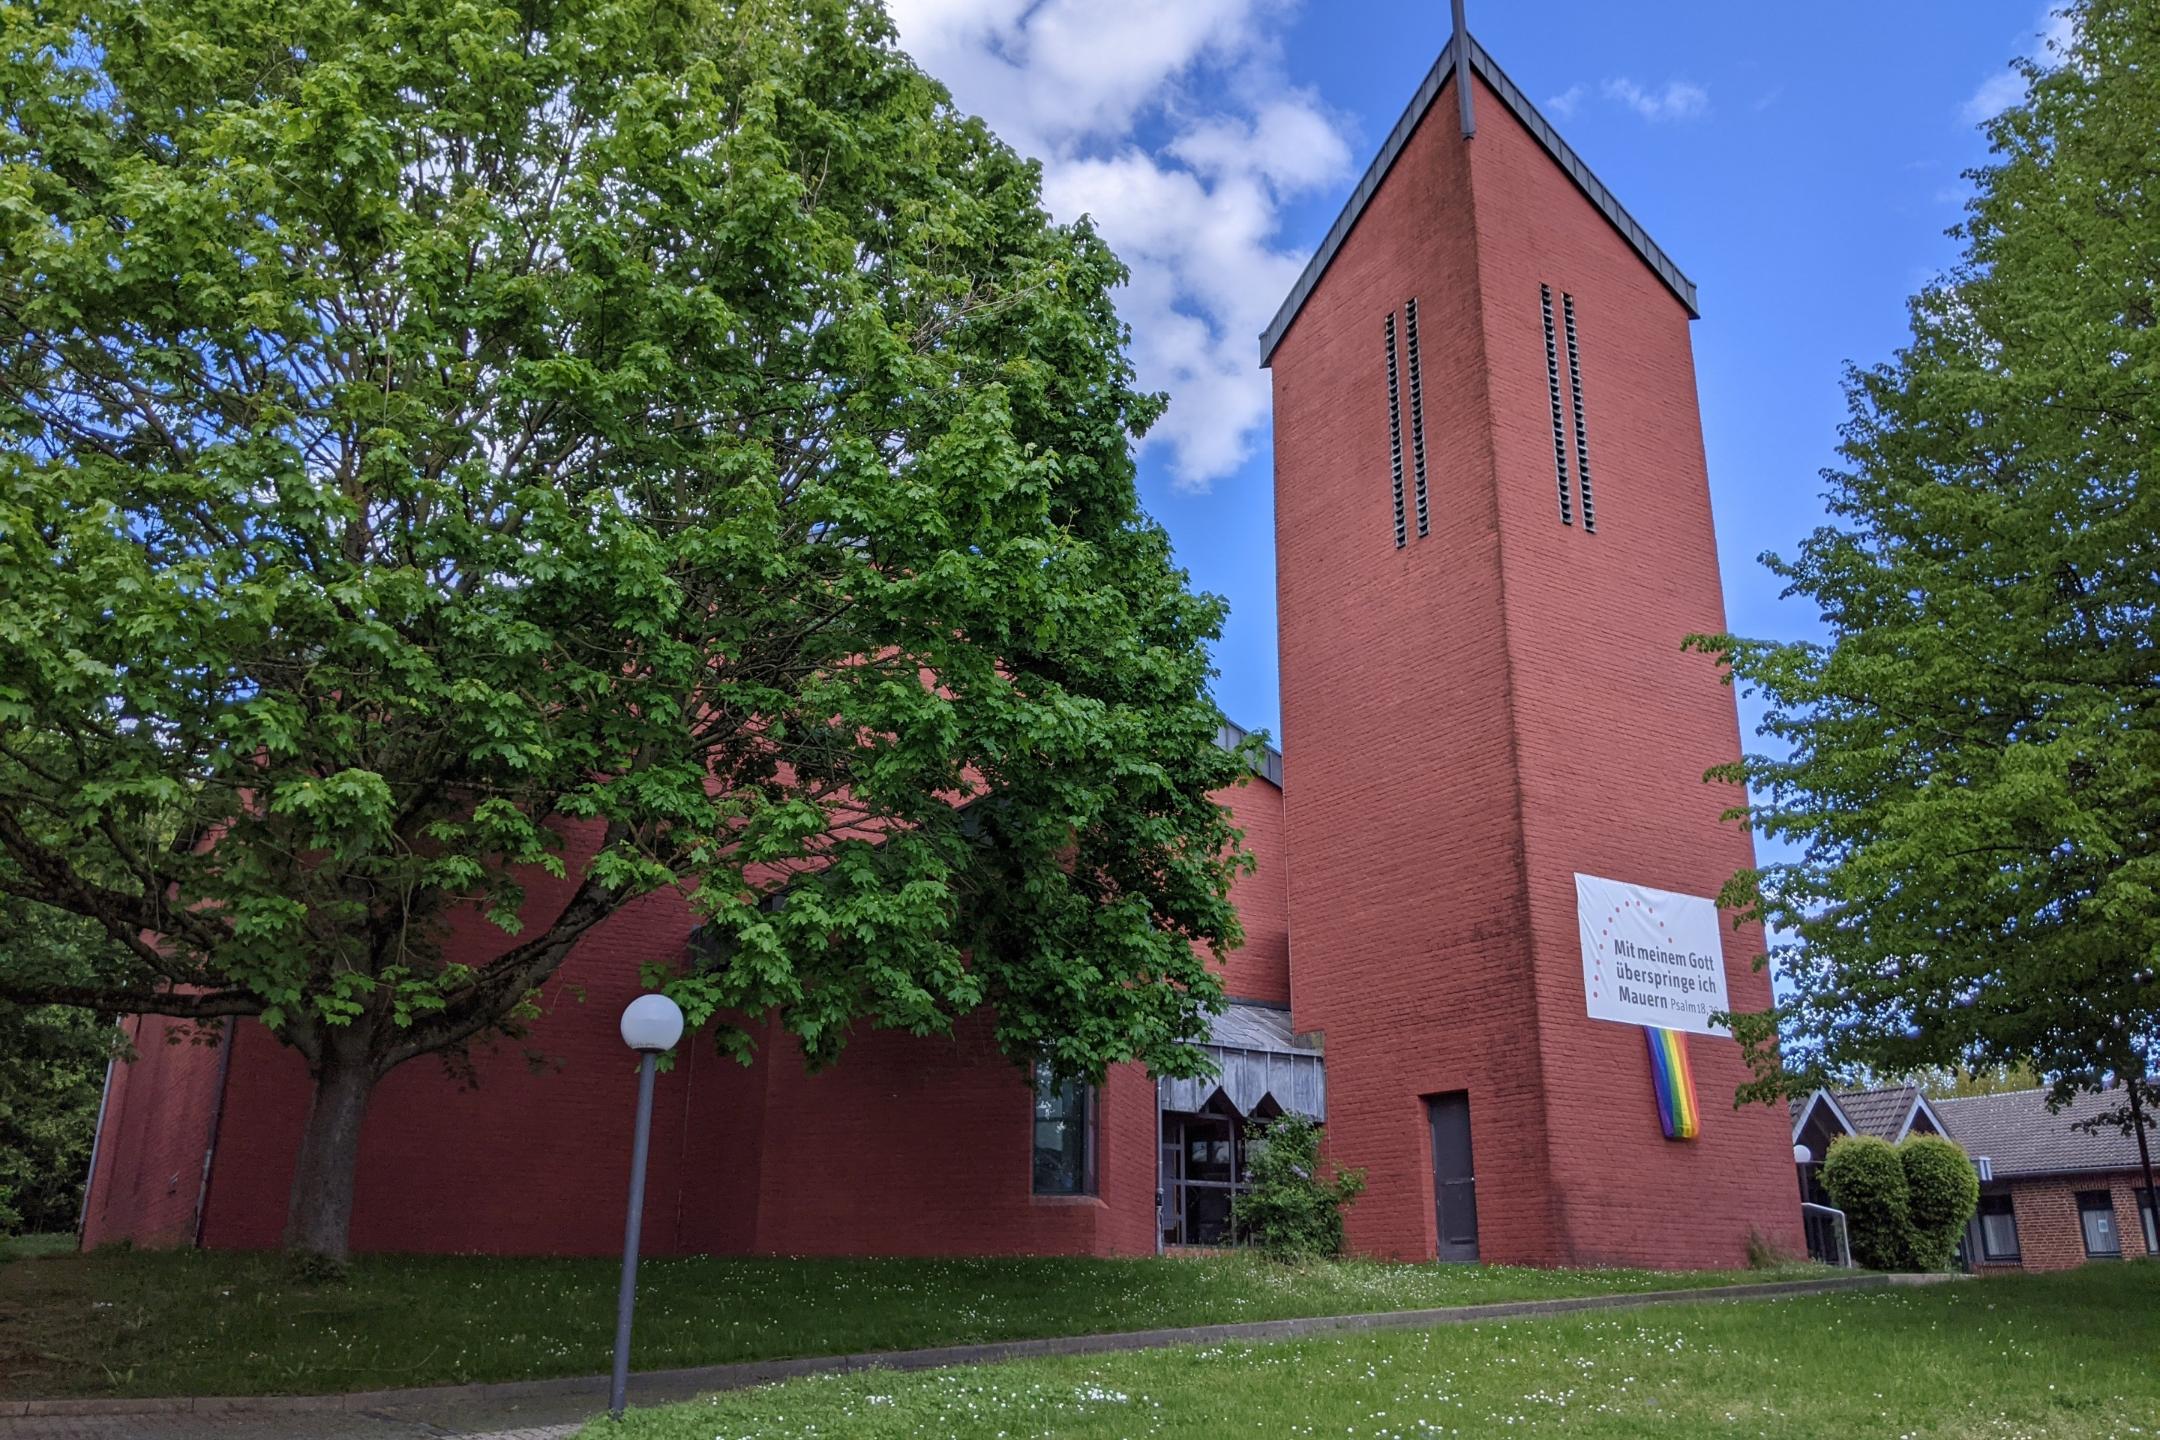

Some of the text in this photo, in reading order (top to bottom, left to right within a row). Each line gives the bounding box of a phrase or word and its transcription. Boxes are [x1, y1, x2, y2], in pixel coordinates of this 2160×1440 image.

[1614, 939, 1714, 971] Mit meinem Gott
[1616, 962, 1716, 993] überspringe ich
[1619, 985, 1667, 1009] Mauern
[1671, 998, 1696, 1012] Psalm
